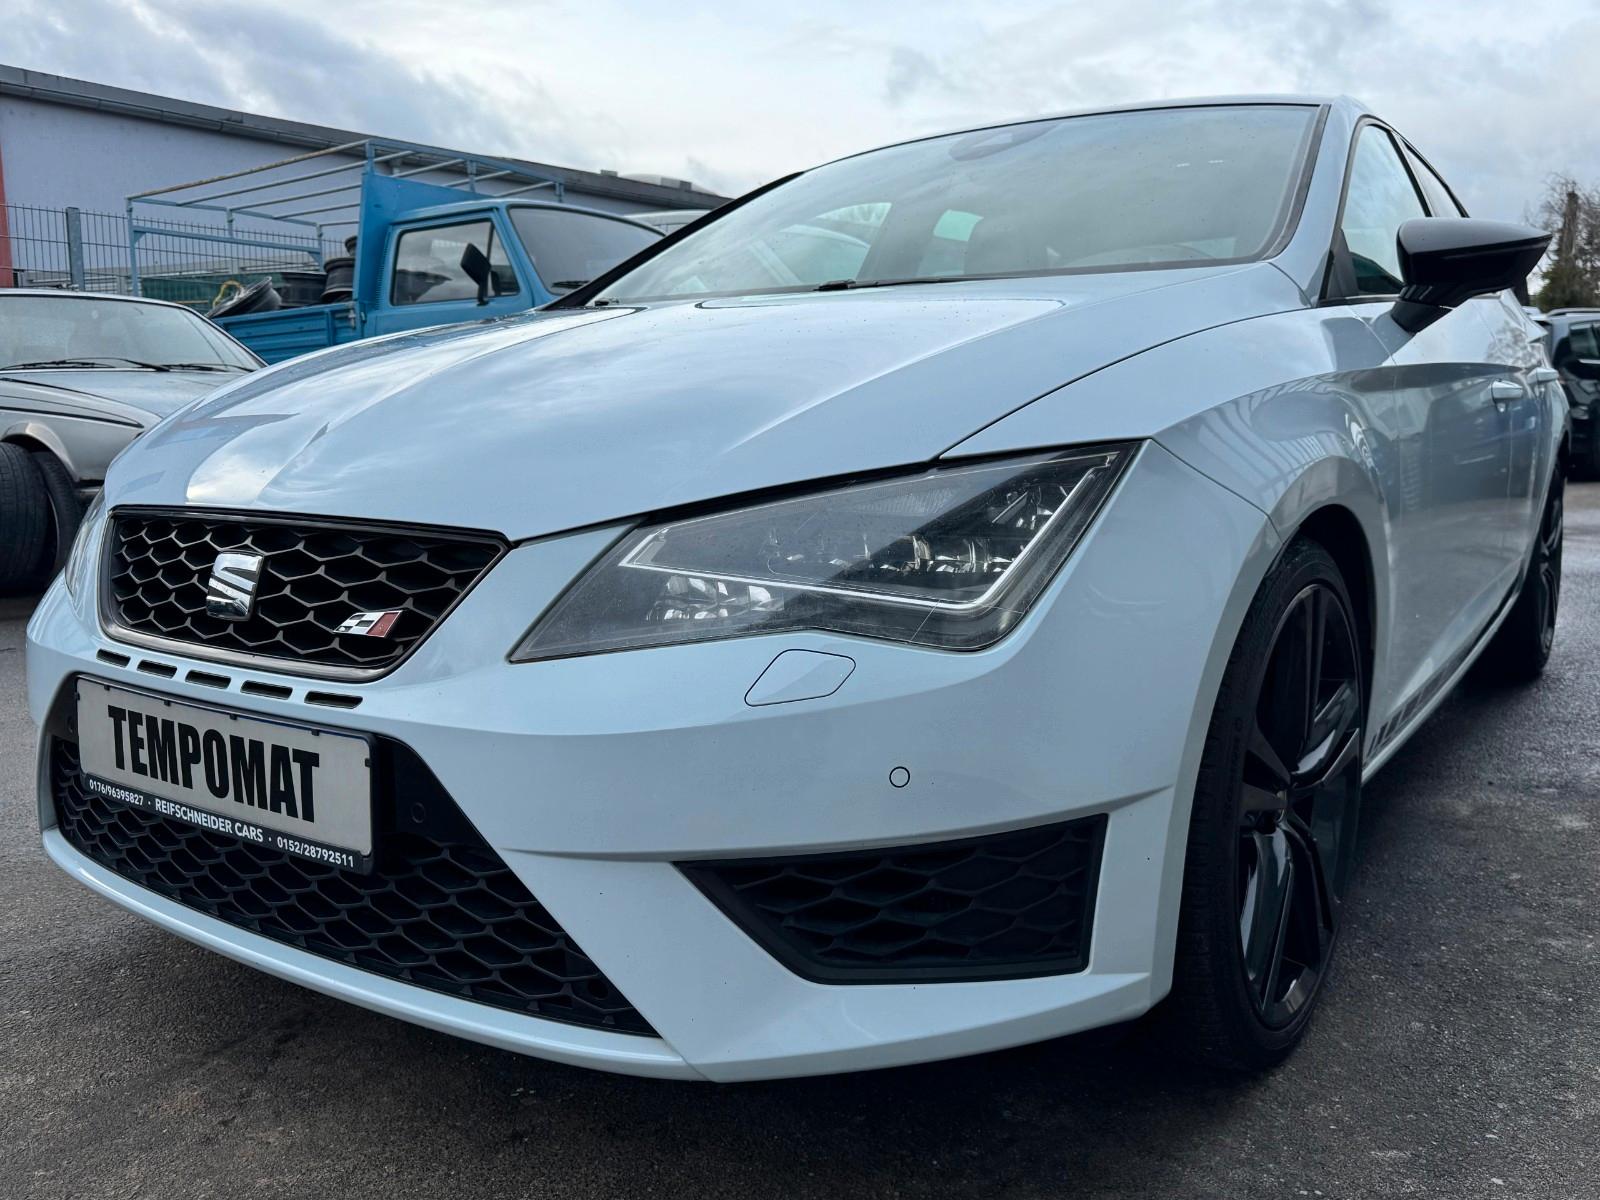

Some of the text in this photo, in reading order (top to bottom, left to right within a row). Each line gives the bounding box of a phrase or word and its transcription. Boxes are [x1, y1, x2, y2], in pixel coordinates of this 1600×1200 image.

[107, 704, 320, 823] TEMPOMAT
[89, 779, 354, 868] 0176/96395827 REIFSCHNEIDER CARS 0152/28792511
